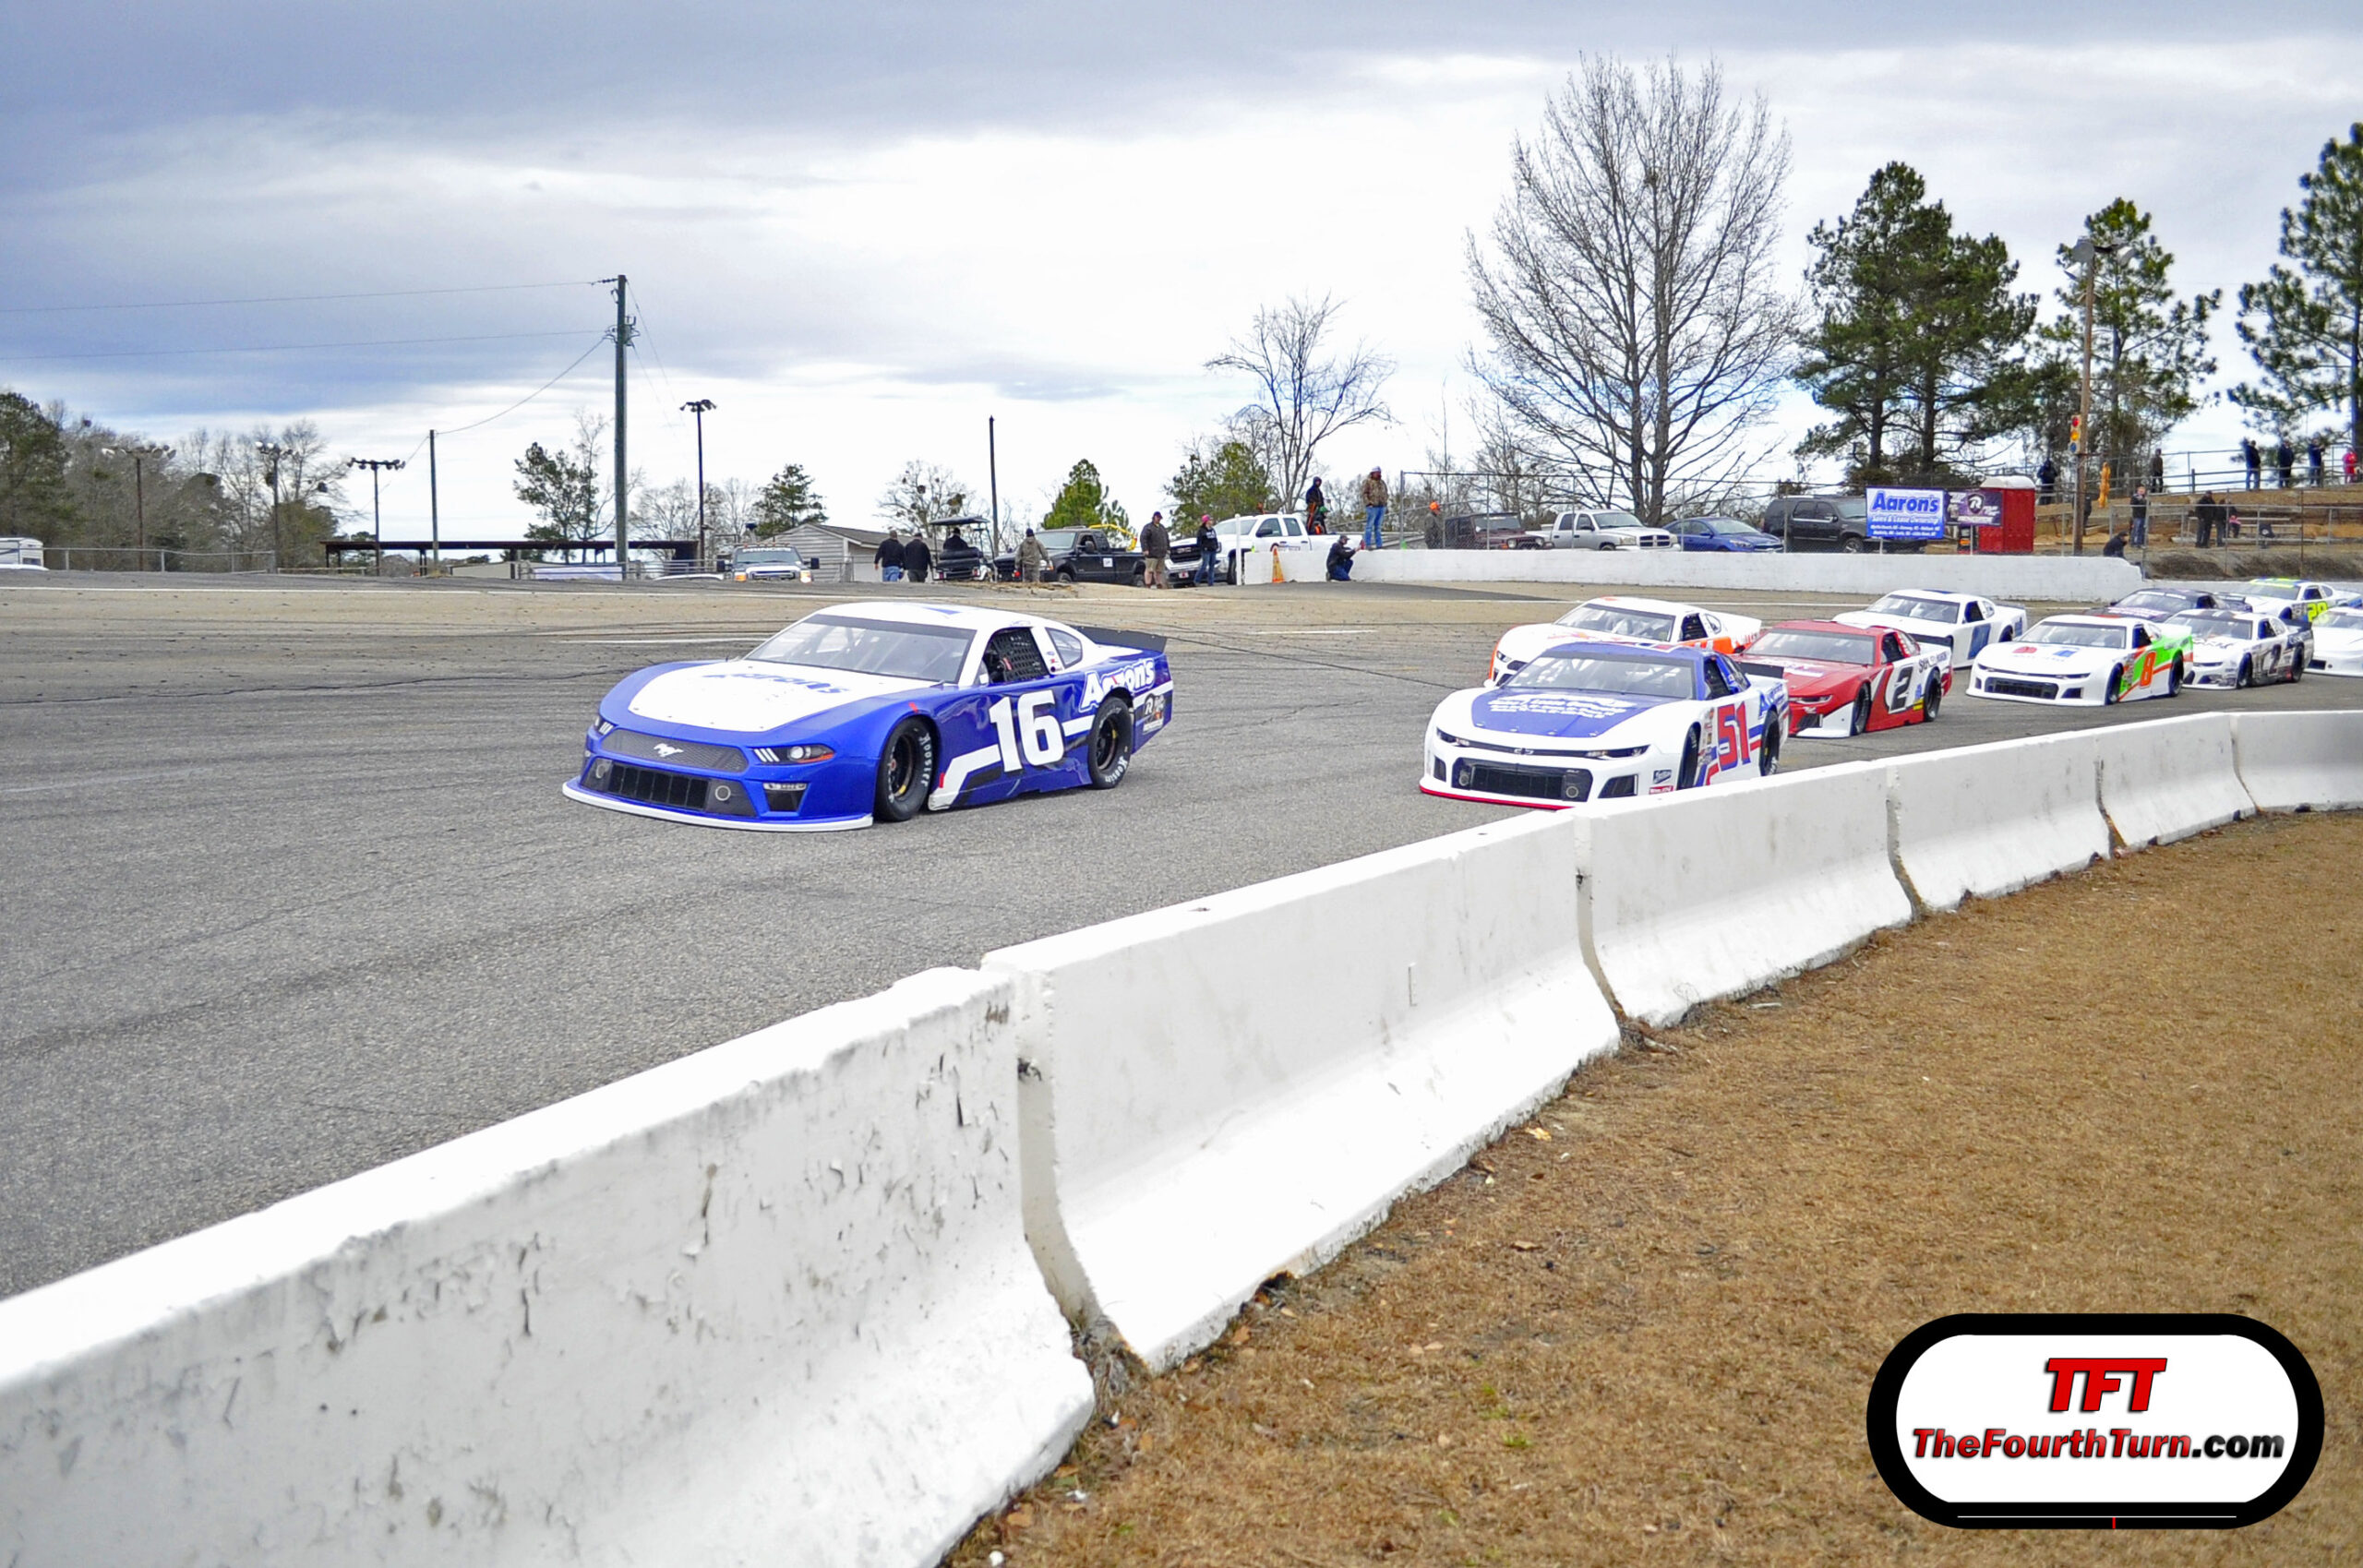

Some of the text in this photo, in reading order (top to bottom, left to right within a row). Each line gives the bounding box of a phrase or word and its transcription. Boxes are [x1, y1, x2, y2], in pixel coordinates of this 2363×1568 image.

[1871, 491, 1940, 513] Aaron's
[1889, 664, 1914, 713] 2
[2140, 651, 2157, 688] 8
[989, 689, 1065, 772] 16
[1717, 700, 1751, 772] 51
